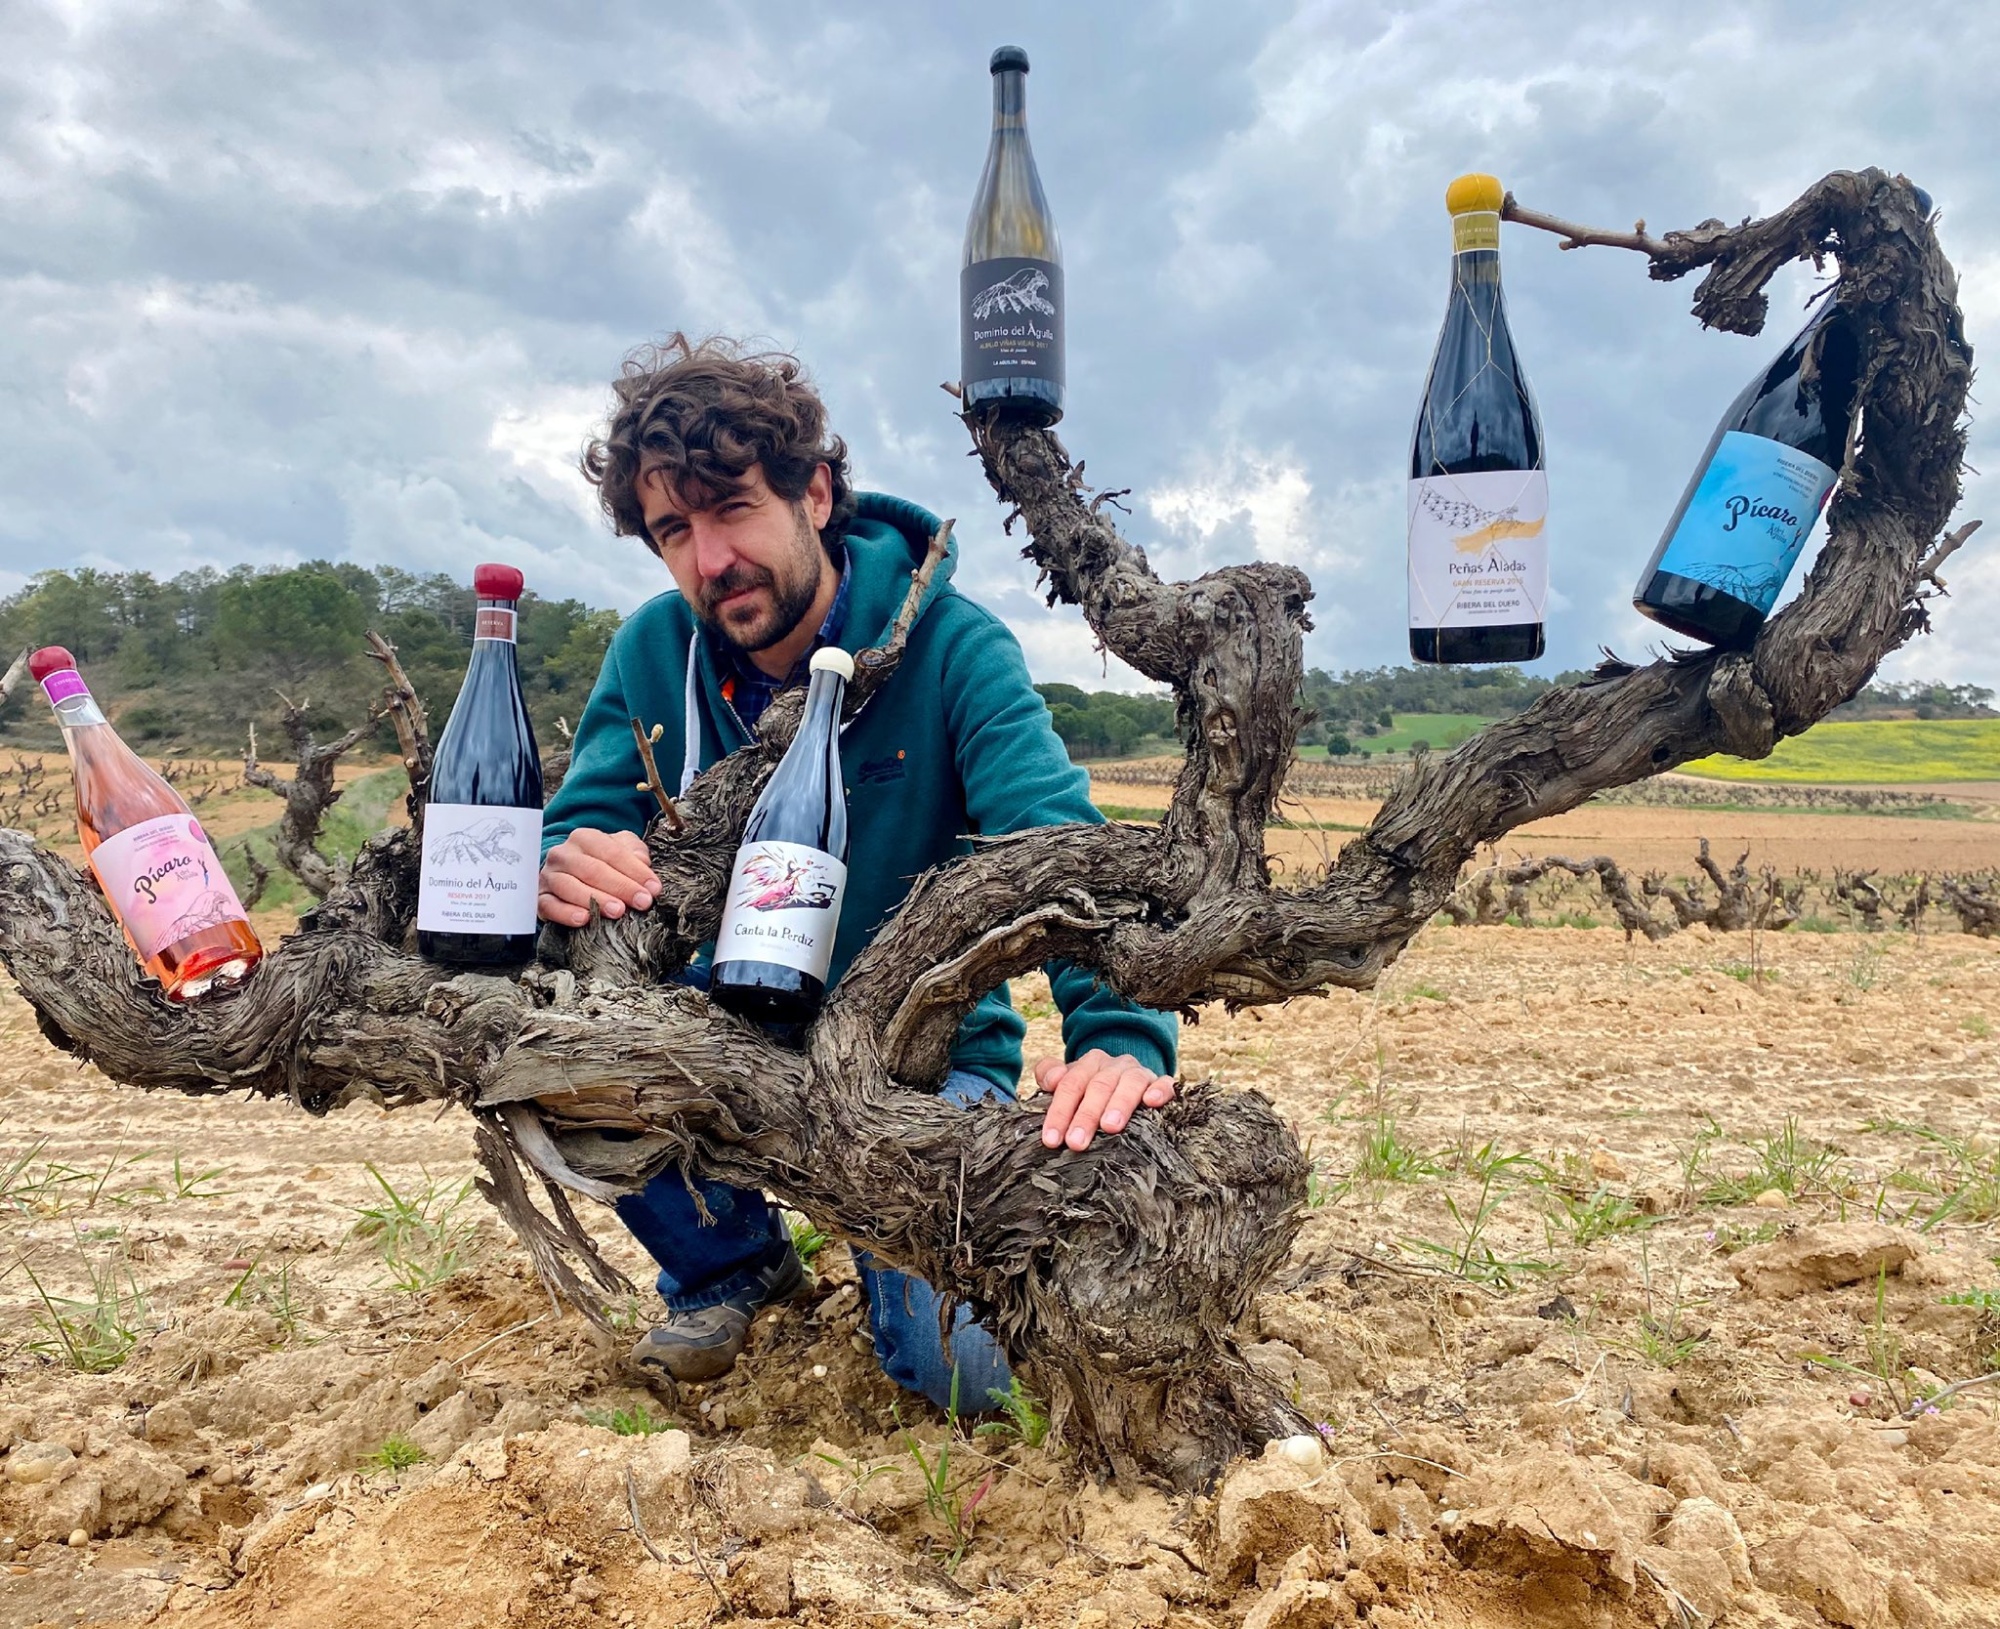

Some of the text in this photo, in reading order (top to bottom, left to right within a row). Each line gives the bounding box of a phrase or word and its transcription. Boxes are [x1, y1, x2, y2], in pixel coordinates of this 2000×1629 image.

[974, 326, 1009, 340] Dominio
[1011, 326, 1025, 336] del
[1722, 494, 1798, 532] Pícaro
[1449, 556, 1527, 575] Peñas Aladas
[1452, 579, 1473, 587] GRAN
[1474, 578, 1505, 586] RESERVA
[1456, 601, 1482, 609] RIBERA
[1498, 599, 1520, 608] DUERO
[134, 855, 193, 905] Pícaro
[428, 876, 464, 888] Dominio
[466, 878, 482, 889] del
[441, 910, 460, 918] RIBERA
[734, 923, 764, 936] Canta
[767, 926, 778, 937] la
[781, 926, 814, 948] Perdiz
